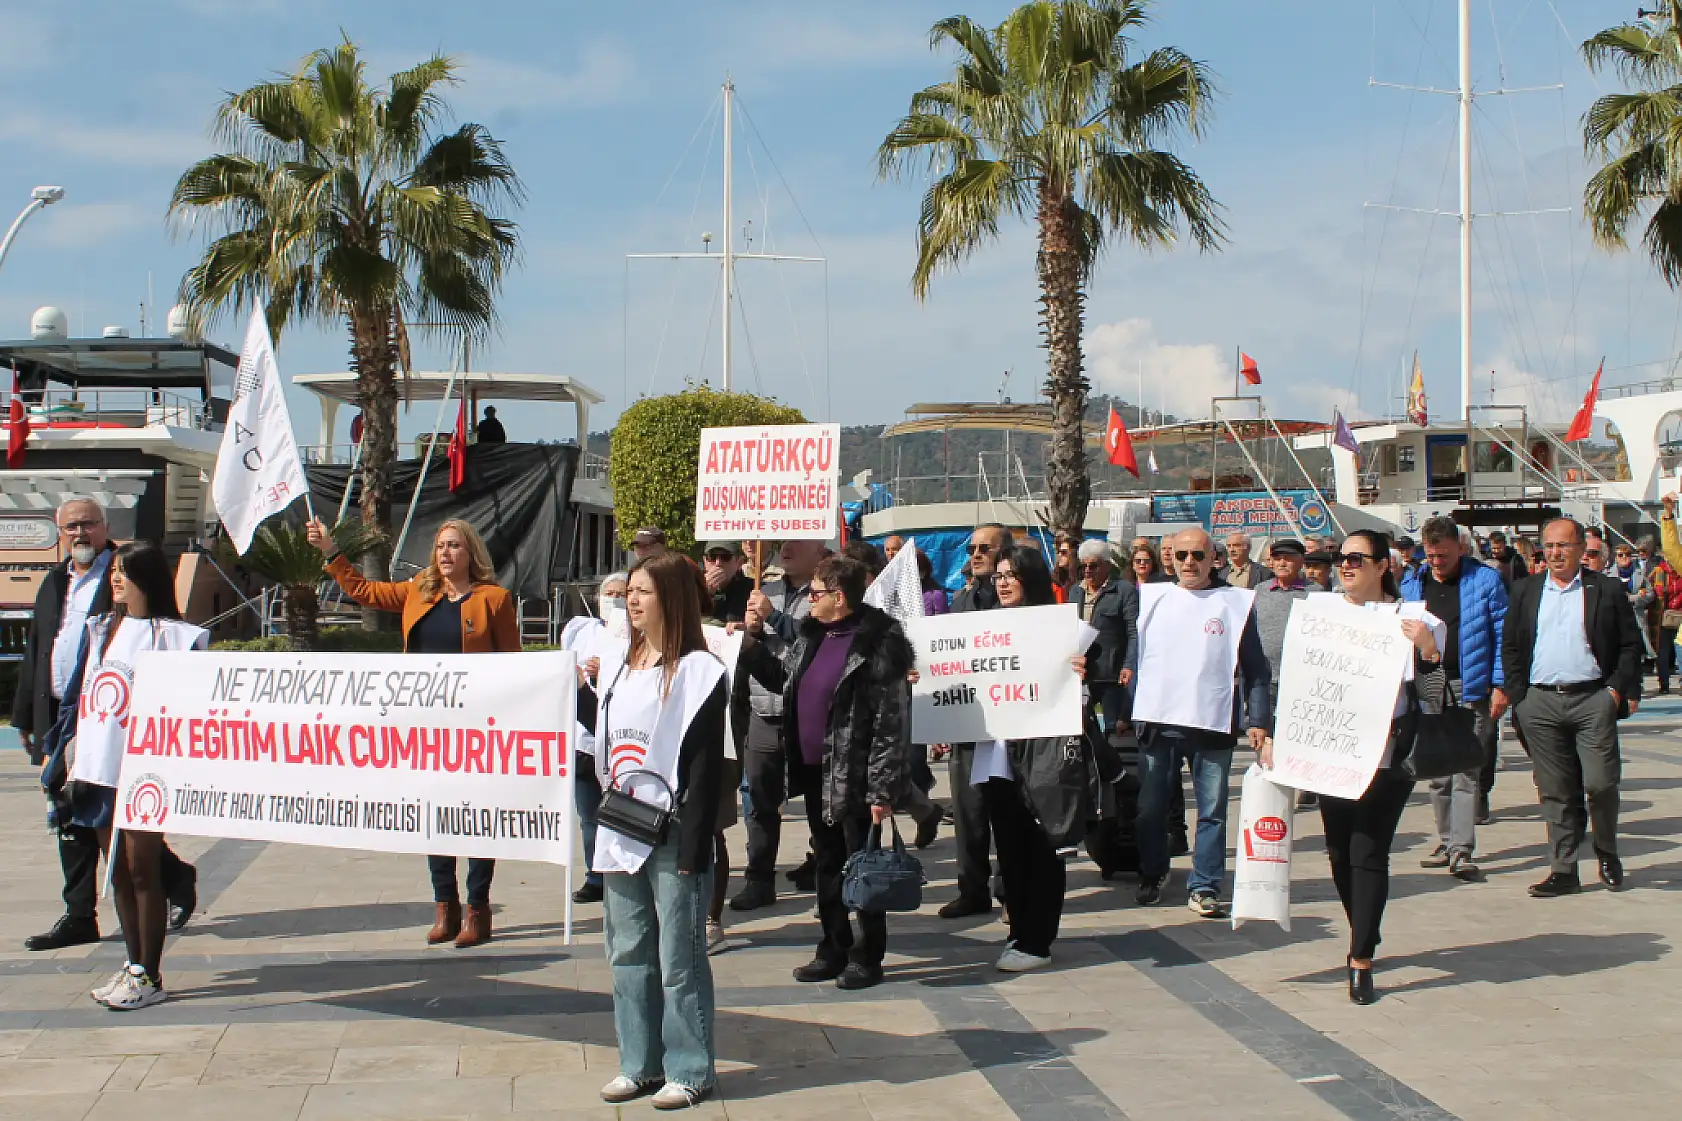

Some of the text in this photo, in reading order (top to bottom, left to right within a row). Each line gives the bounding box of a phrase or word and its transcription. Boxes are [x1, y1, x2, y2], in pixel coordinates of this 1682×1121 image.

[705, 430, 833, 480] ATATÜRKÇÜ
[703, 479, 831, 518] DÜŞÜNCE DERNEĞİ
[705, 516, 826, 533] FETHİYE ŞUBESİ
[973, 631, 1012, 648] EĞME
[930, 655, 1020, 676] MEMLEKETE
[211, 660, 468, 716] NE TARİKAT NE ŞERİAT:
[932, 683, 977, 706] SAHİP
[127, 706, 567, 777] LAİK EĞİTİM LAİK CUMHURİYET!
[174, 783, 228, 818] TÜRKİYE
[229, 792, 266, 821] HALK
[269, 791, 359, 829] TEMSİLCİLERİ
[363, 797, 421, 832] MECLİSİ
[436, 801, 561, 840] MUĞLA/FETHİYE
